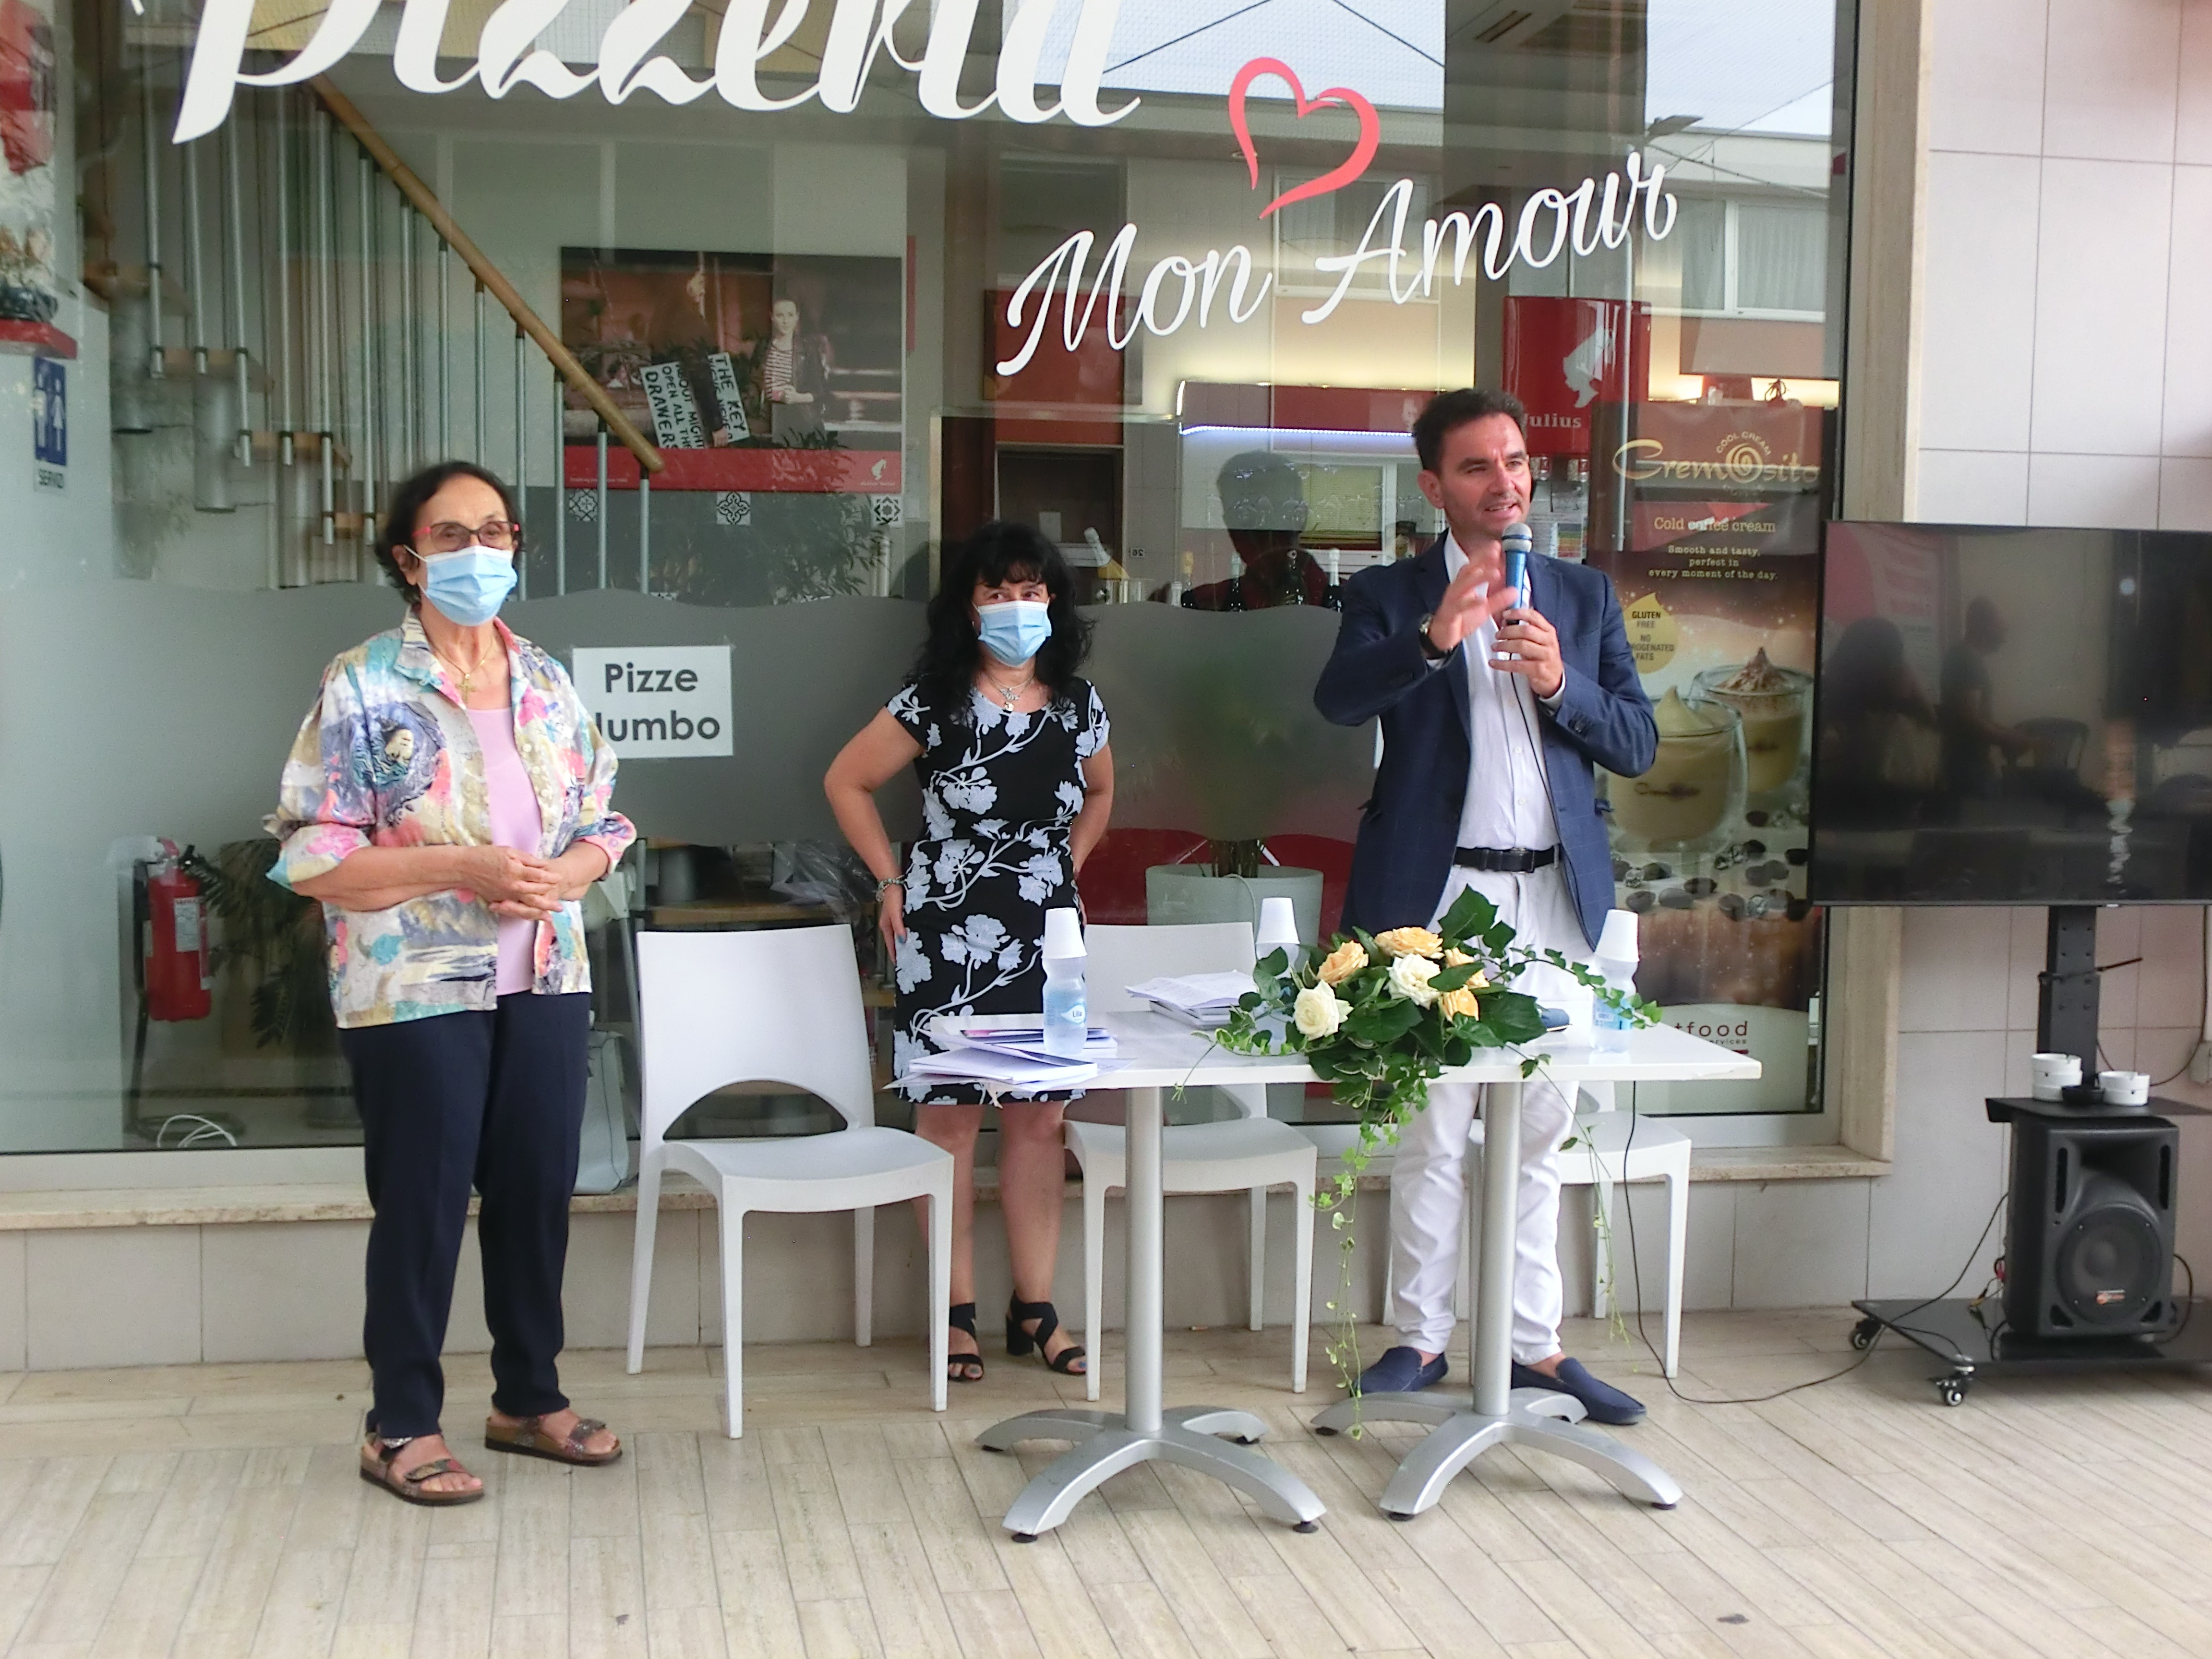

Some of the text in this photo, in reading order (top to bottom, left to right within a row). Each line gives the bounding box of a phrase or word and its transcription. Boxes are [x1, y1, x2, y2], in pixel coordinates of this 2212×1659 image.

[996, 152, 1678, 376] Mon Amour
[662, 365, 679, 399] OPEN
[673, 403, 685, 425] ALL
[716, 355, 734, 390] THE
[727, 399, 746, 432] KEY
[1716, 431, 1772, 456] COOL CREAM
[1654, 517, 1685, 529] Cold
[1731, 521, 1776, 532] cream
[1668, 544, 1706, 554] Smooth
[1709, 546, 1728, 555] and
[1688, 558, 1739, 567] perfect in
[1648, 569, 1679, 579] every
[1681, 569, 1723, 577] moment
[1725, 570, 1735, 578] of
[1737, 570, 1755, 579] the
[1632, 611, 1661, 619] GLUTEN
[605, 662, 698, 693] Pizze
